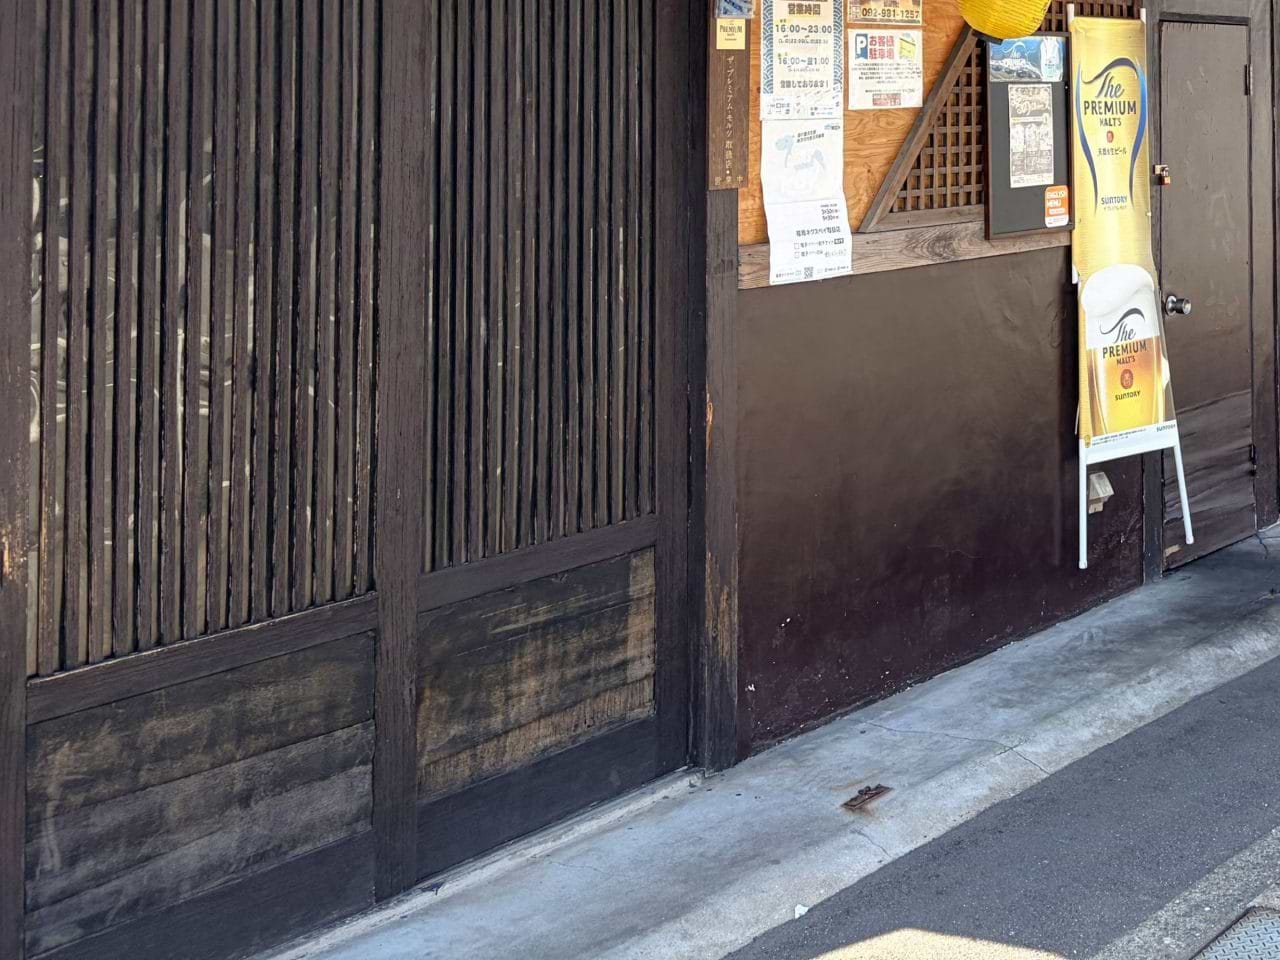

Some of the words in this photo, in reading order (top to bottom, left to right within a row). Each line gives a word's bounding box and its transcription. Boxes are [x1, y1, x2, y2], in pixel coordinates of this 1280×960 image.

[1083, 100, 1137, 116] PREMIUM
[1102, 339, 1148, 359] PREMIUM
[1114, 390, 1141, 401] SUNTORY
